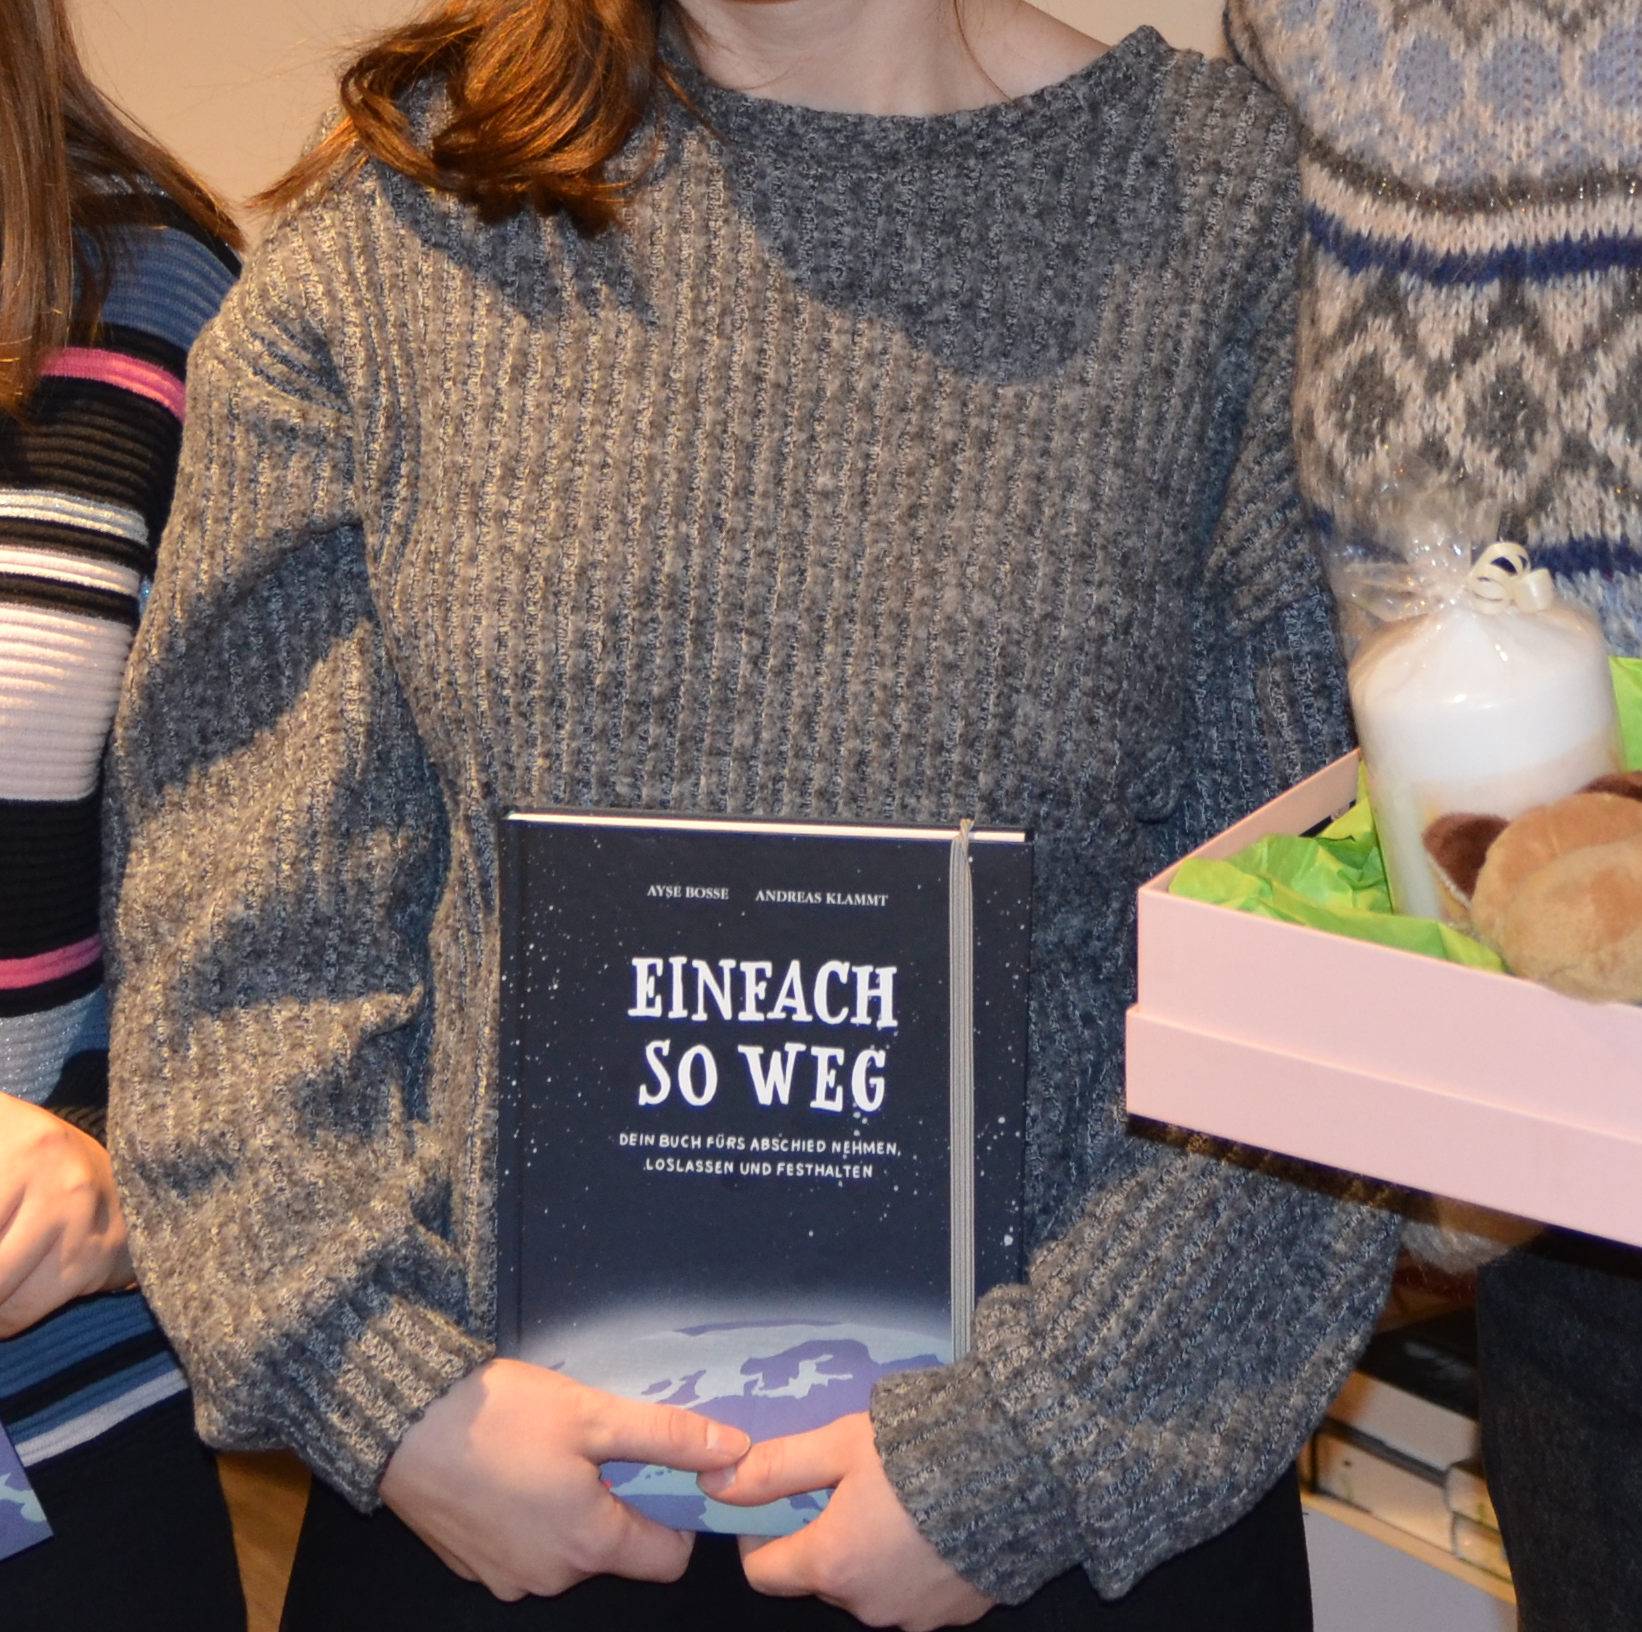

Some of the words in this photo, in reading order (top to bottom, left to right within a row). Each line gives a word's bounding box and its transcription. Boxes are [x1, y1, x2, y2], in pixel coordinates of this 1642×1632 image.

[685, 885, 729, 901] BOSSE
[755, 889, 822, 904] ANDREAS
[825, 892, 889, 908] KLAMMT
[627, 956, 898, 1030] EINFACH
[638, 1039, 718, 1107] SO
[737, 1042, 887, 1113] WEG
[619, 1132, 656, 1148] DEIN
[659, 1134, 703, 1150] BUCH
[706, 1132, 746, 1151] FÜRS
[749, 1137, 827, 1154] ABSCHIED
[830, 1140, 902, 1157] NEHMEN,
[645, 1157, 735, 1175] LOSLASSEN
[739, 1161, 772, 1176] UND
[777, 1162, 873, 1179] FESTHALTEN
